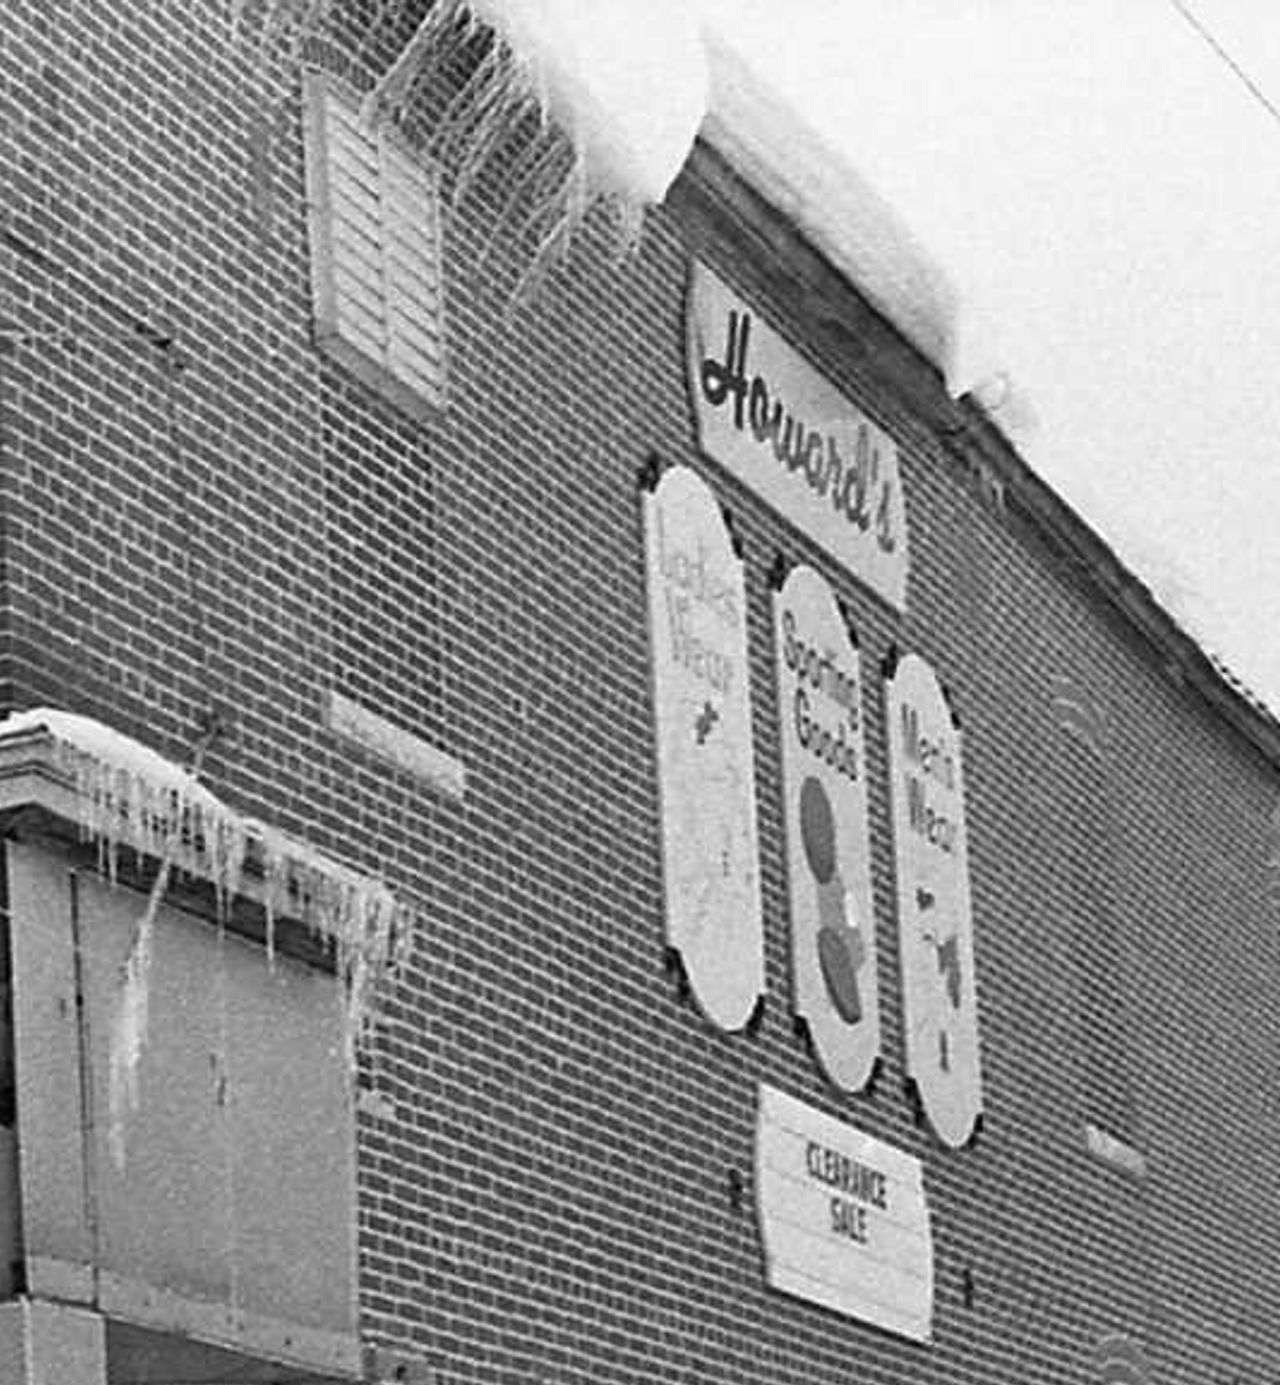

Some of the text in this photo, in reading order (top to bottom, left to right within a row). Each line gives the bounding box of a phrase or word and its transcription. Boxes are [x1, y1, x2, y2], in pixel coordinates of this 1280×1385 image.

[701, 309, 896, 554] Howard's
[794, 685, 857, 784] Goods
[830, 1196, 868, 1244] SALE
